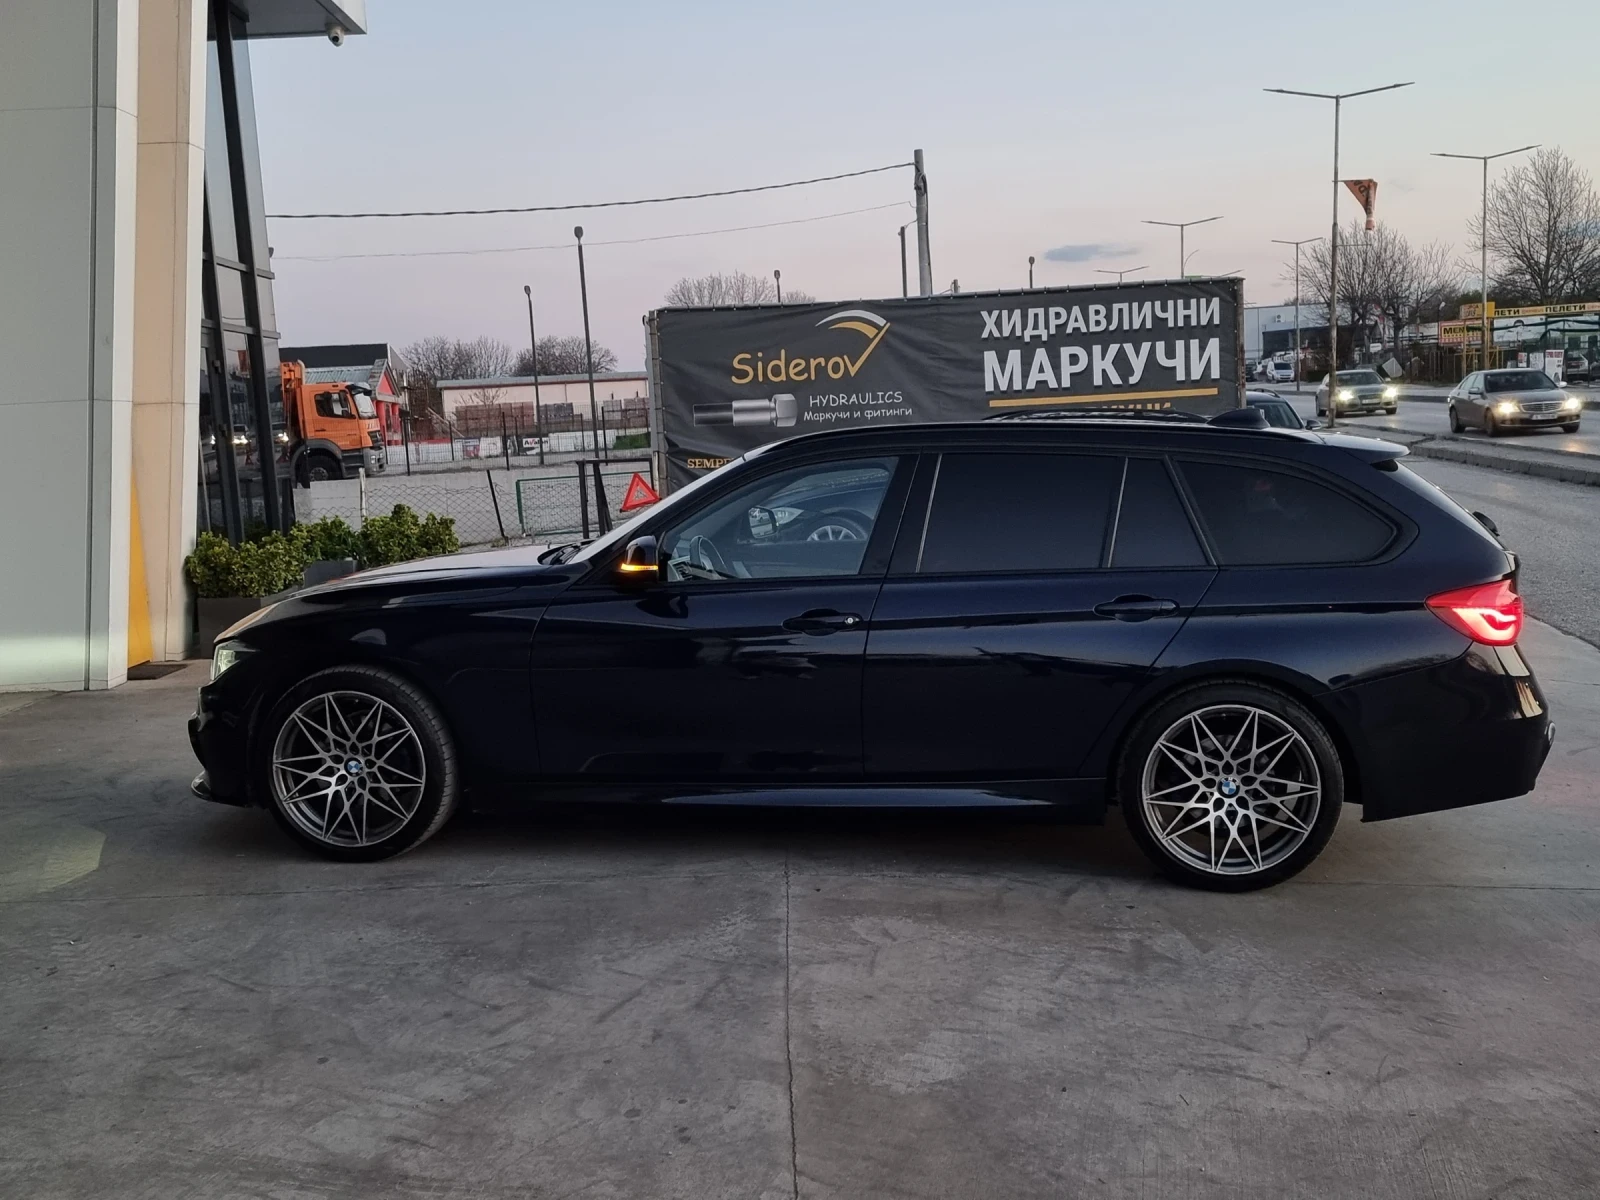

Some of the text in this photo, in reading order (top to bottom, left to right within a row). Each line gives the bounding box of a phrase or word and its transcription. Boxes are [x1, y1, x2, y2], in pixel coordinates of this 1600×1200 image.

[980, 296, 1220, 343] ХИДРАВЛИЧНИ
[731, 322, 890, 385] Siderov
[984, 337, 1220, 393] МАРКУЧИ
[803, 408, 912, 423] Маркучи и фитинги
[809, 391, 903, 407] HYDRAULICS
